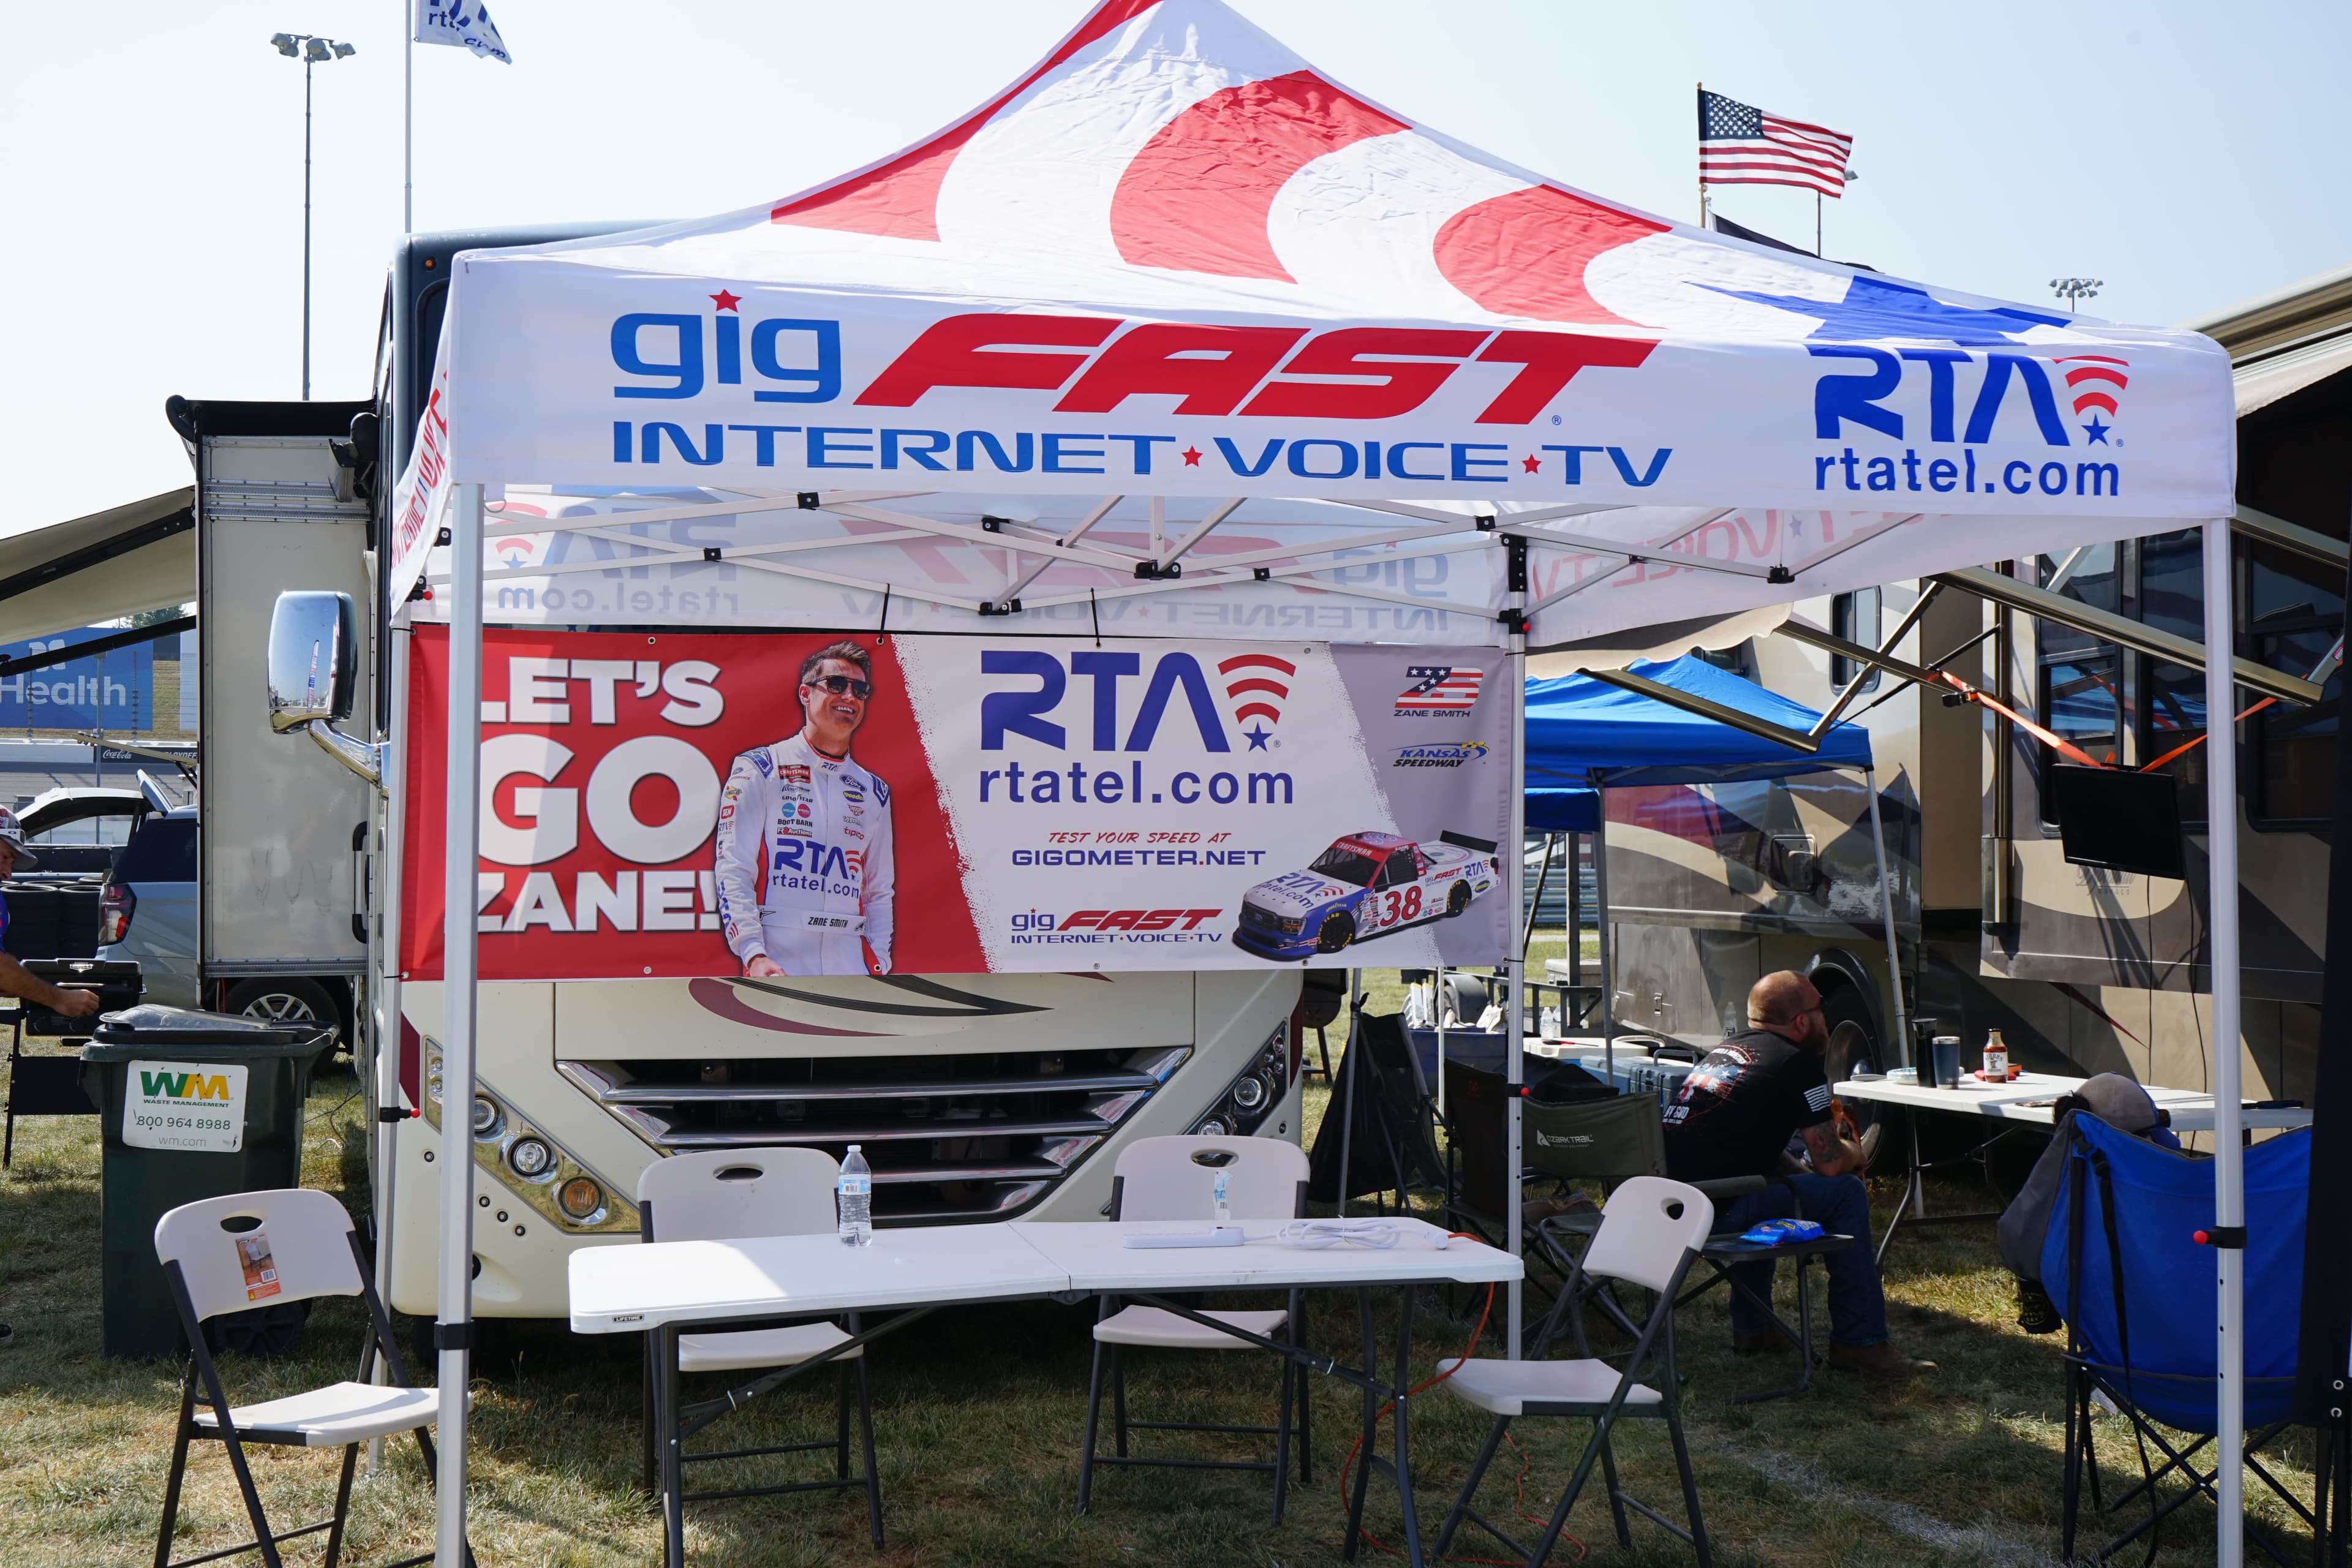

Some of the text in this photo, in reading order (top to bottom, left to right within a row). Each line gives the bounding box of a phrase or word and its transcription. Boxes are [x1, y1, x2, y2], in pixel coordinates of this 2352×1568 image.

[611, 289, 1662, 424] gig FAST
[1806, 344, 2071, 447] RTA
[613, 421, 1674, 488] INTERNET VOICE TV
[1815, 448, 2120, 497] rtatel.com
[0, 673, 126, 706] Health
[981, 650, 1232, 753] RTA
[1393, 759, 1465, 768] SPEEDWAY
[1400, 748, 1471, 758] KANSAS
[980, 760, 1294, 805] rtatel.com
[480, 733, 723, 864] GO
[796, 819, 813, 827] BARN
[1048, 832, 1232, 843] TEST YOUR SPEED AT
[1336, 842, 1373, 856] CRAFTSMAN
[774, 837, 849, 880] RTA
[1011, 850, 1267, 866] GIGOMETER.NET
[773, 873, 860, 899] rtatel.com
[1434, 867, 1462, 881] FAST
[478, 870, 719, 933] ZANE!
[1380, 886, 1422, 927] 38
[808, 916, 848, 928] ZANE SMITH
[1011, 908, 1224, 932] gig FAST
[1011, 933, 1223, 944] INTERNET VOICE TV
[140, 1071, 230, 1101] WM
[137, 1116, 231, 1130] 800 964 8988
[158, 1137, 206, 1147] wm.com
[1547, 1135, 1594, 1144] OZARK TRAIL
